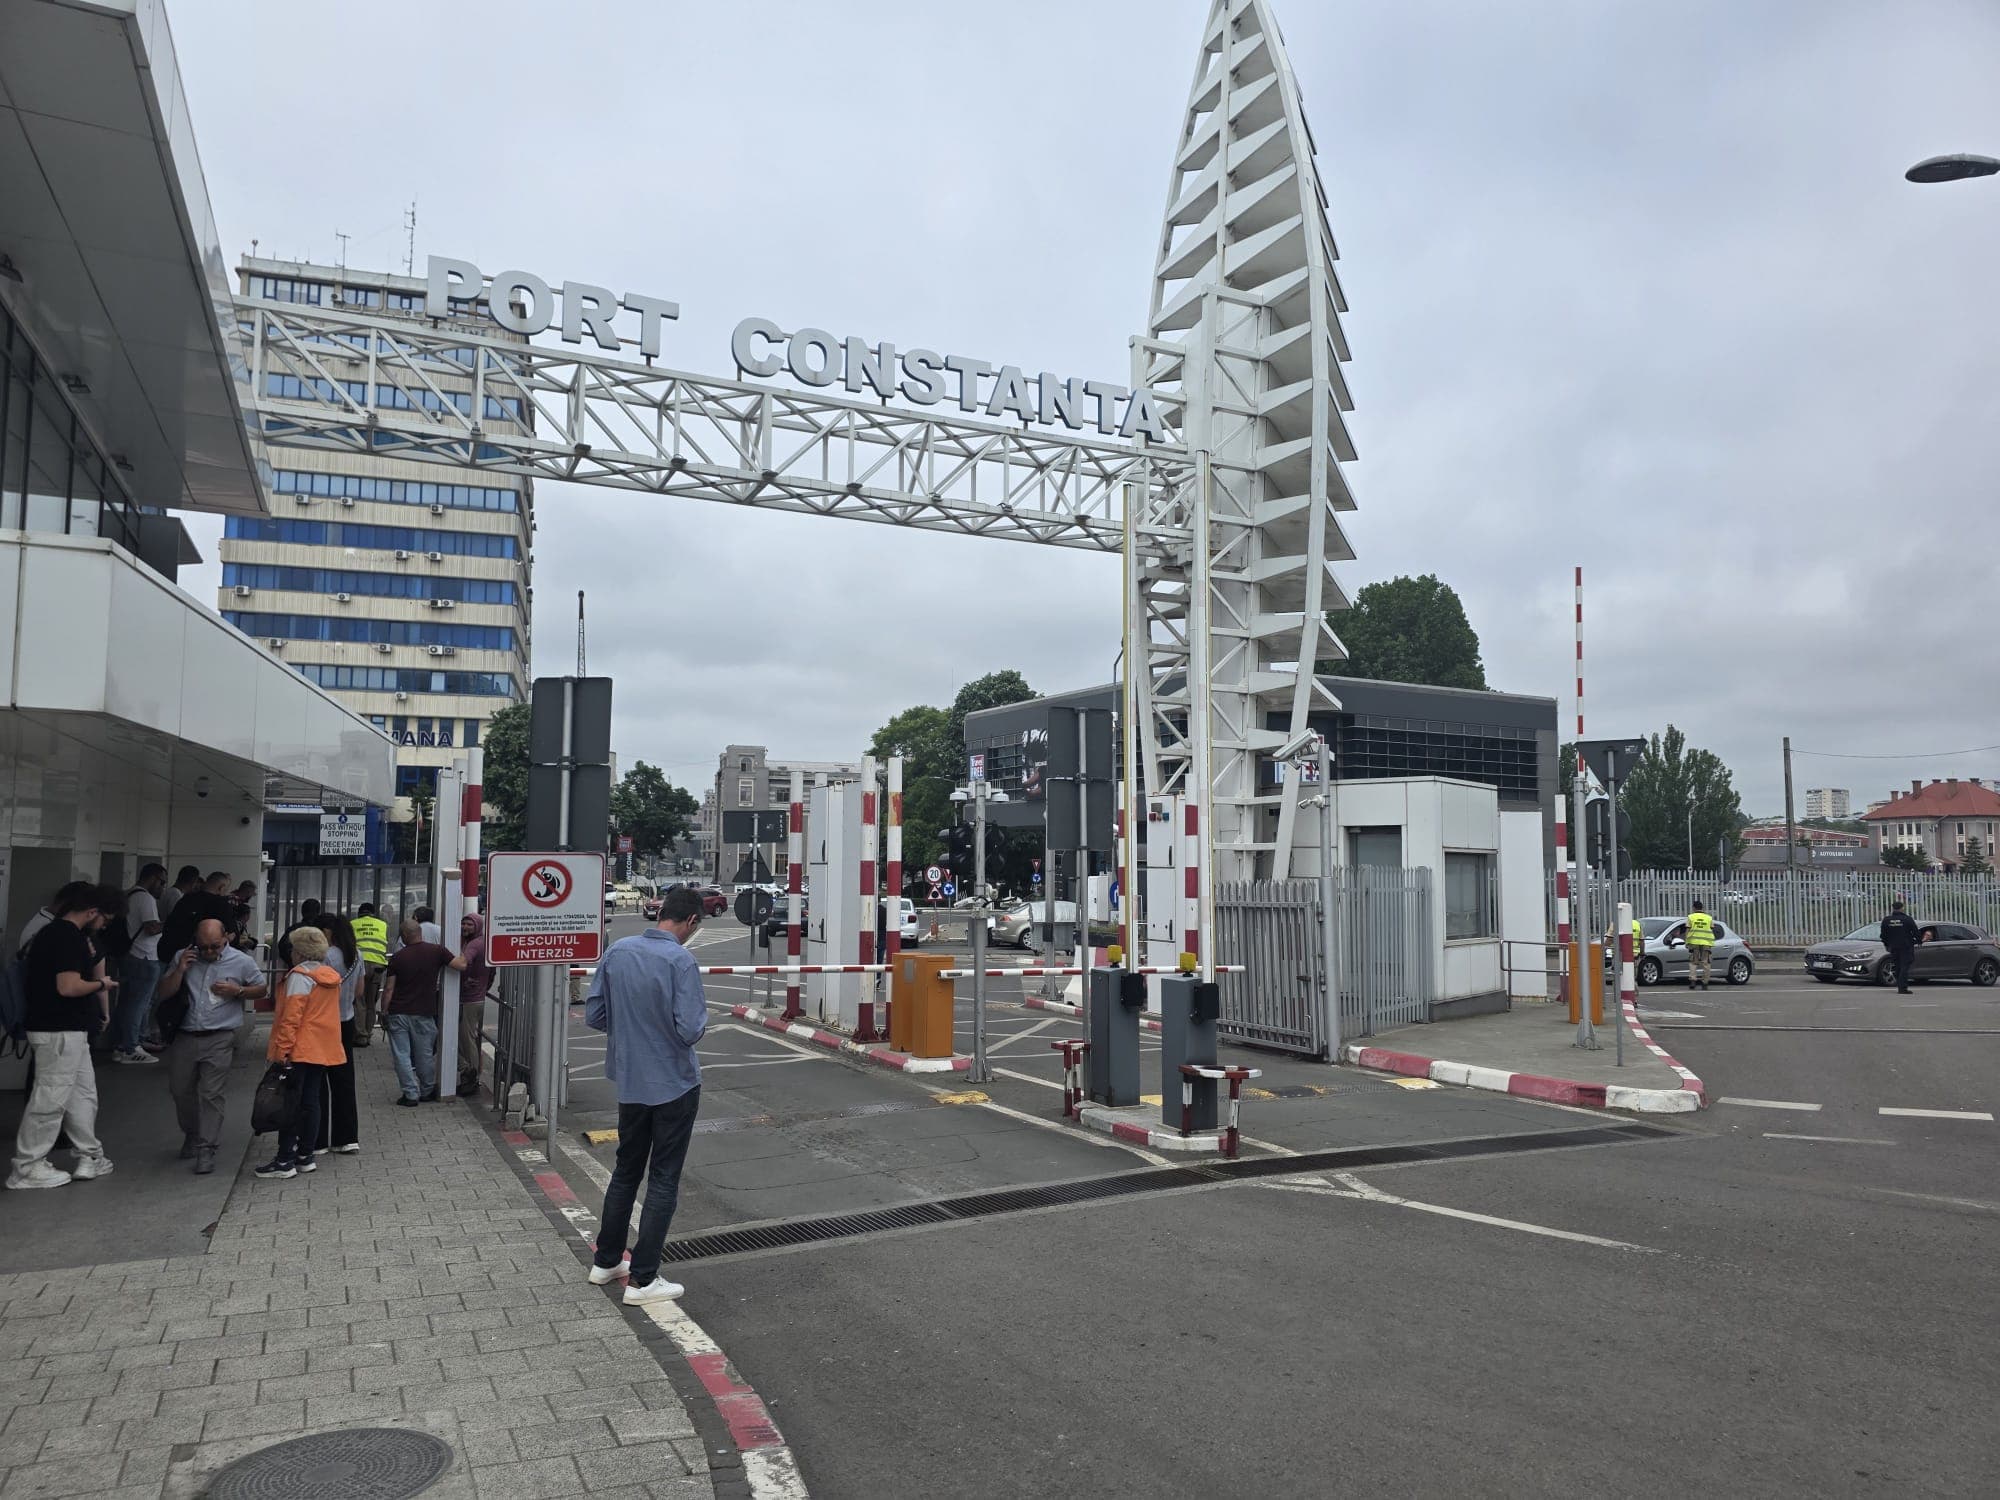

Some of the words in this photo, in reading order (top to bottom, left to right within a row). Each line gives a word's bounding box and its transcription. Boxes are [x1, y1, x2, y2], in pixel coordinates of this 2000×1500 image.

[426, 254, 680, 358] PORT
[731, 317, 1165, 443] CONSTANTA
[320, 823, 336, 831] PASS
[338, 823, 365, 831] WITHOUT
[930, 870, 939, 879] 20
[511, 935, 580, 947] PESCUITUL
[516, 948, 574, 959] INTERZIS
